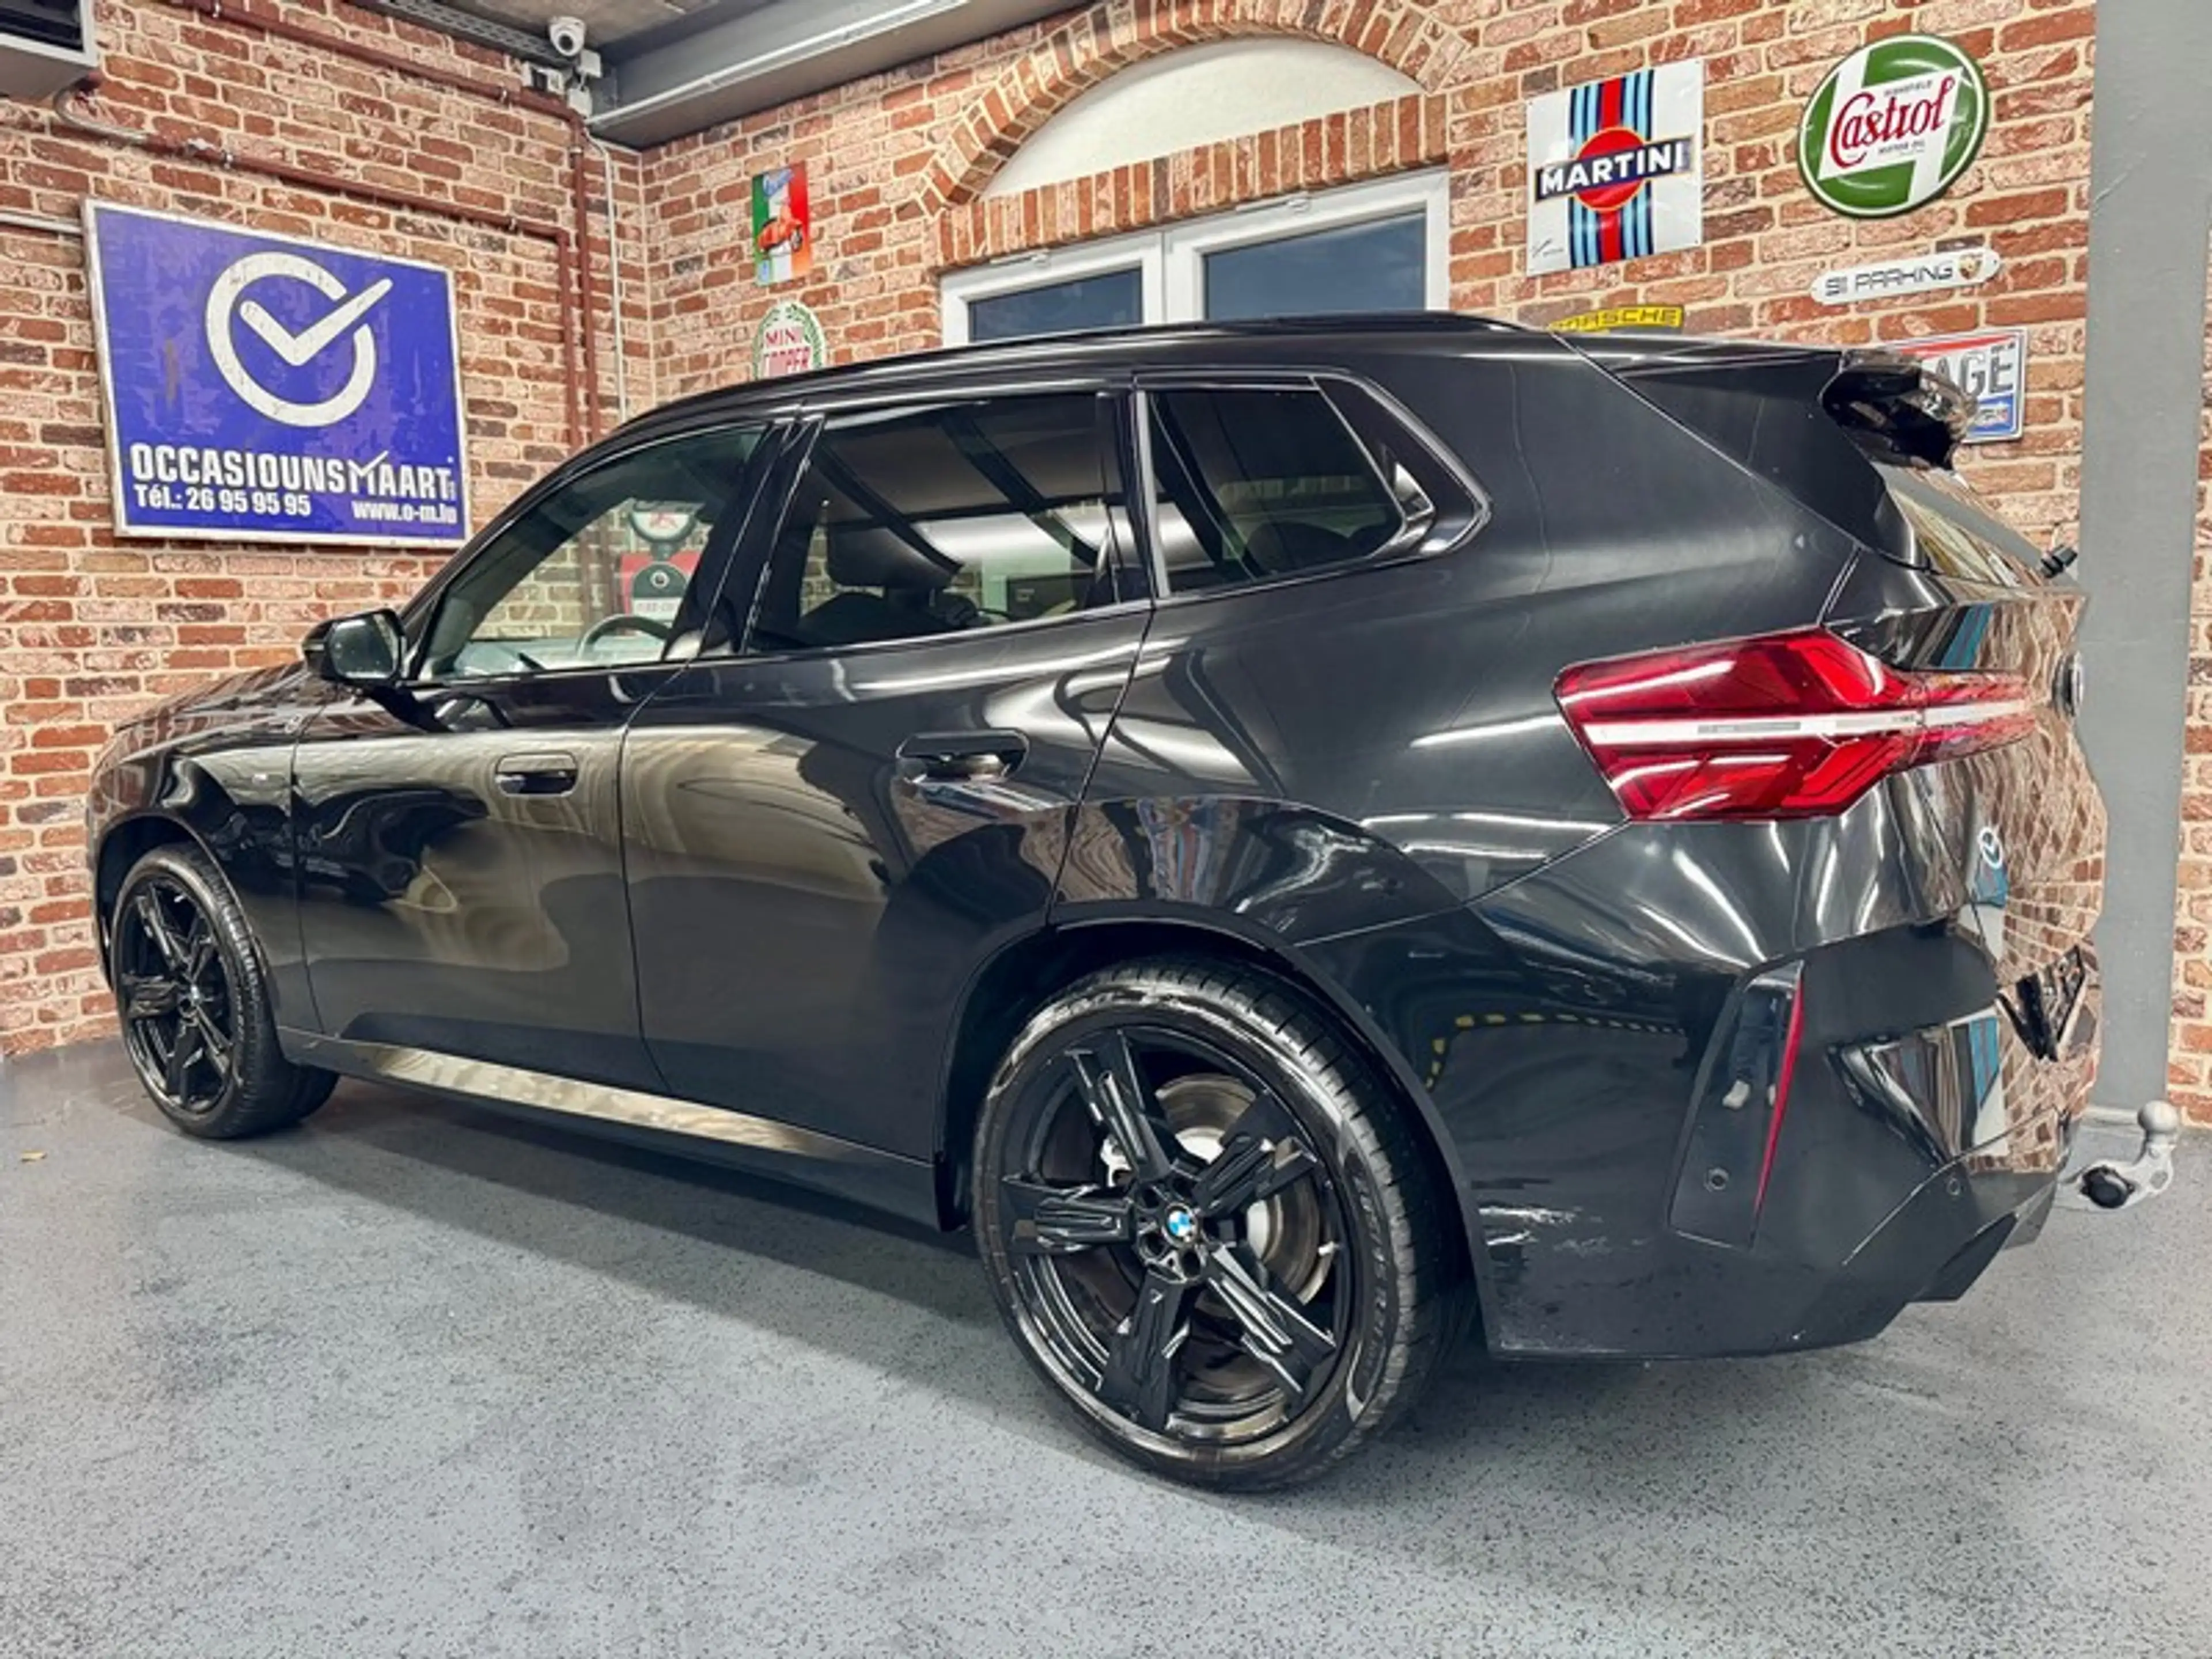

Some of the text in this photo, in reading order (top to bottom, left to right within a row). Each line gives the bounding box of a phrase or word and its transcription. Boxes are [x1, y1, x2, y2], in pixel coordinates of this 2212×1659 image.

[1831, 75, 1956, 169] Castrol
[1541, 142, 1683, 195] MARTINI
[1855, 260, 1953, 292] PARKING
[185, 487, 215, 513] 26
[218, 488, 249, 514] 95
[252, 491, 281, 516] 95
[284, 493, 312, 517] 95
